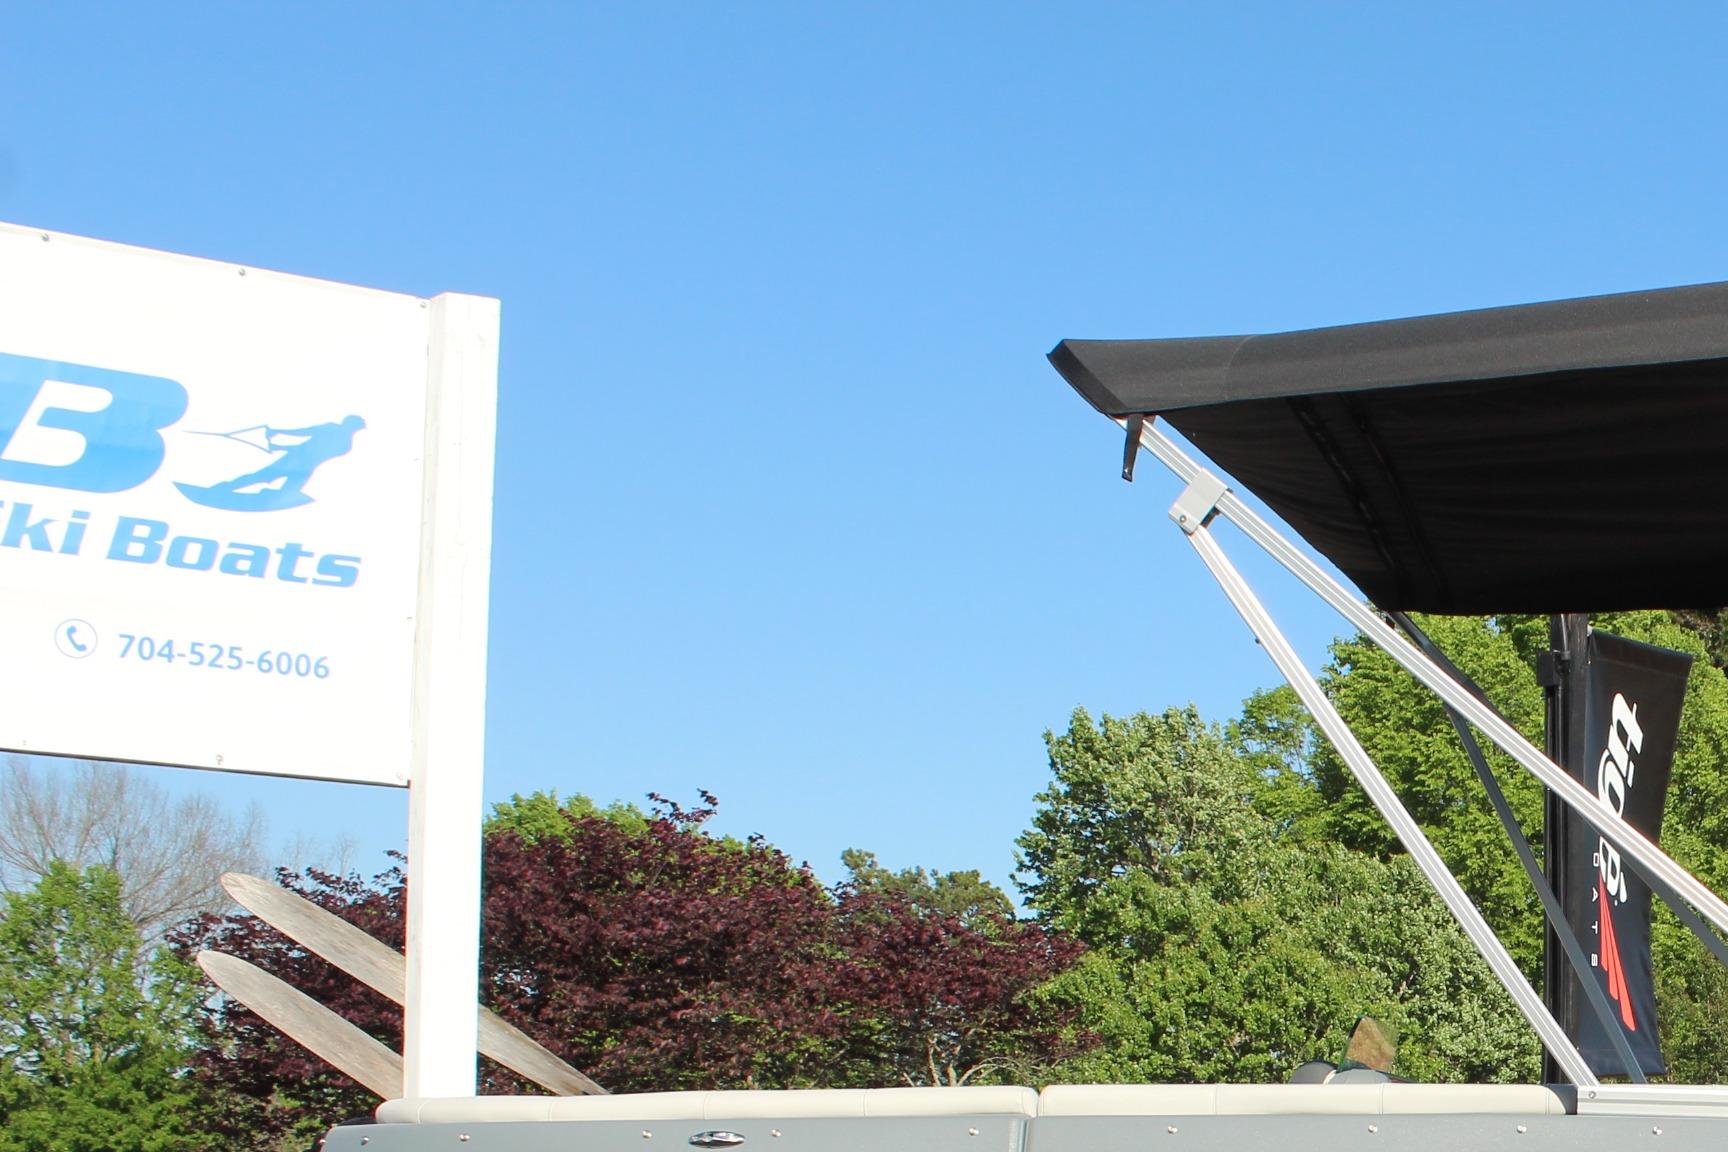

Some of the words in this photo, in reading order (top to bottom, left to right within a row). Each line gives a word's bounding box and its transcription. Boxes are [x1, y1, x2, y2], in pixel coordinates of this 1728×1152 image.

[0, 499, 92, 556] ki
[105, 514, 362, 589] Boats
[117, 632, 331, 679] 704-525-6006
